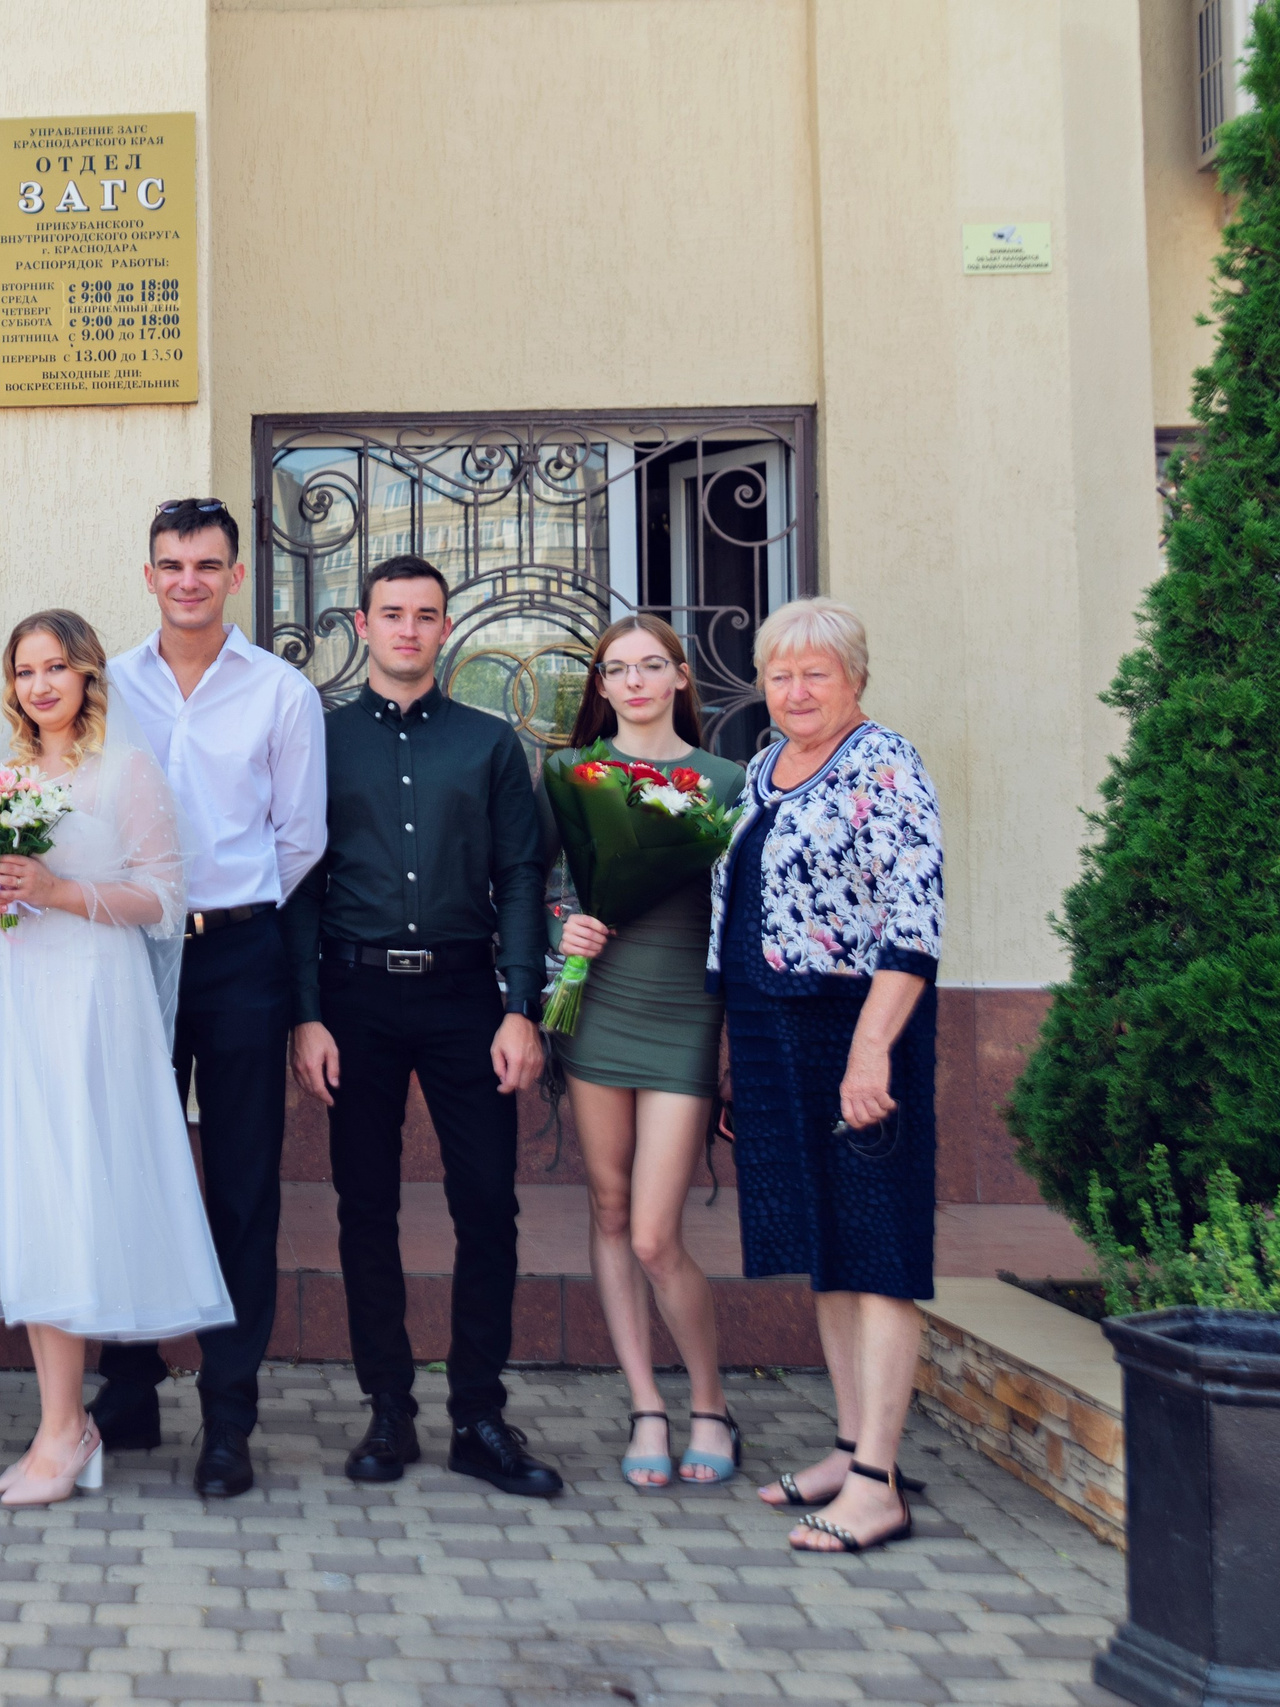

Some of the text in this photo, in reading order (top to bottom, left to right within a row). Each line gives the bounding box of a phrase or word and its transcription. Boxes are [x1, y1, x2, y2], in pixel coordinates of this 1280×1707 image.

[30, 125, 148, 137] УПРАВЛЕНИЕ ЗАГС
[13, 136, 164, 149] КРАСНОДАРСКОГО КРАЯ
[35, 154, 142, 175] ОТДЕЛ
[18, 177, 166, 214] ЗАГС
[36, 219, 144, 231] ПРИКУБАНСКОГО
[0, 230, 180, 244] ВНУТРИГОРОДСКОГО ОКРУГА
[54, 243, 138, 254] КРАСНОДАРА
[16, 258, 169, 270] РАСПОРЯДОК РАБОТЫ:
[1, 279, 179, 292] ВТОРНИК с 9:00 до 18:00
[1, 290, 179, 304] СРЕДА с 9:00 до 18:00
[1, 304, 179, 316] ЧЕТВЕРГ НЕПРИЕМНЫЙ ДЕНЬ
[1, 314, 180, 327] СУББОТА с 9:00 до 18:00
[2, 334, 59, 343] ПЯТНИЦА
[81, 328, 114, 341] 9.00
[118, 332, 135, 342] до
[139, 327, 181, 340] 17.00
[2, 354, 57, 363] ПЕРЕРЫВ
[75, 349, 117, 362] 13.00
[120, 353, 136, 363] до
[42, 369, 142, 380] ВЫХОДНЫЕ ДНИ:
[5, 379, 180, 391] ВОСКРЕСЕНЬЕ, ПОНЕДЕЛЬНИК
